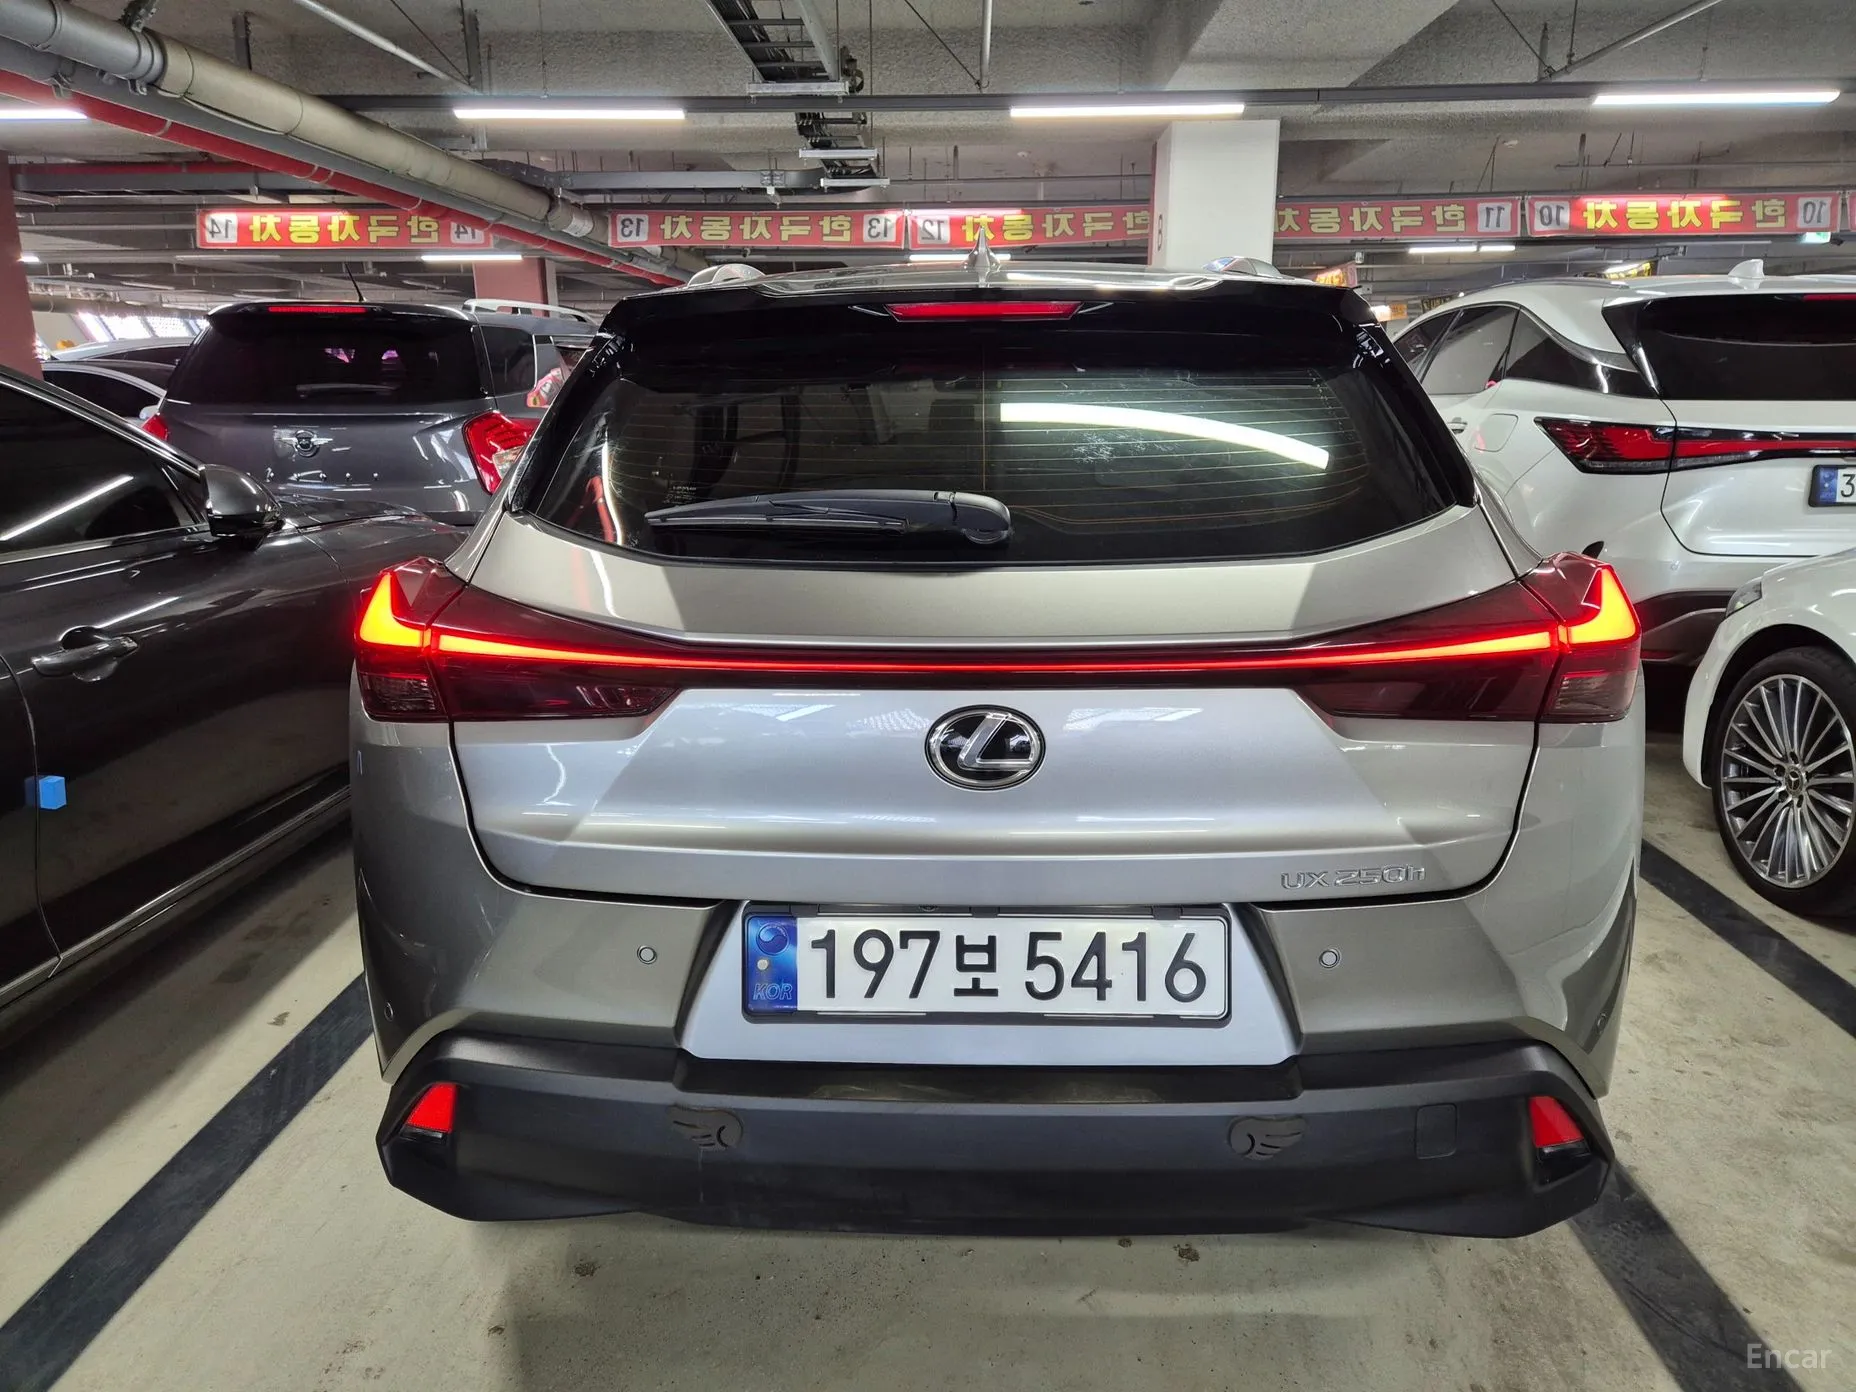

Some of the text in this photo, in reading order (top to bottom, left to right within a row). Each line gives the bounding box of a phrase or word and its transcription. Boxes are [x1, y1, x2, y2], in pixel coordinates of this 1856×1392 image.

[1840, 473, 1856, 498] 3
[1280, 863, 1426, 890] UX 250h
[811, 928, 1207, 1003] 197보 5416
[753, 983, 793, 1000] KOR
